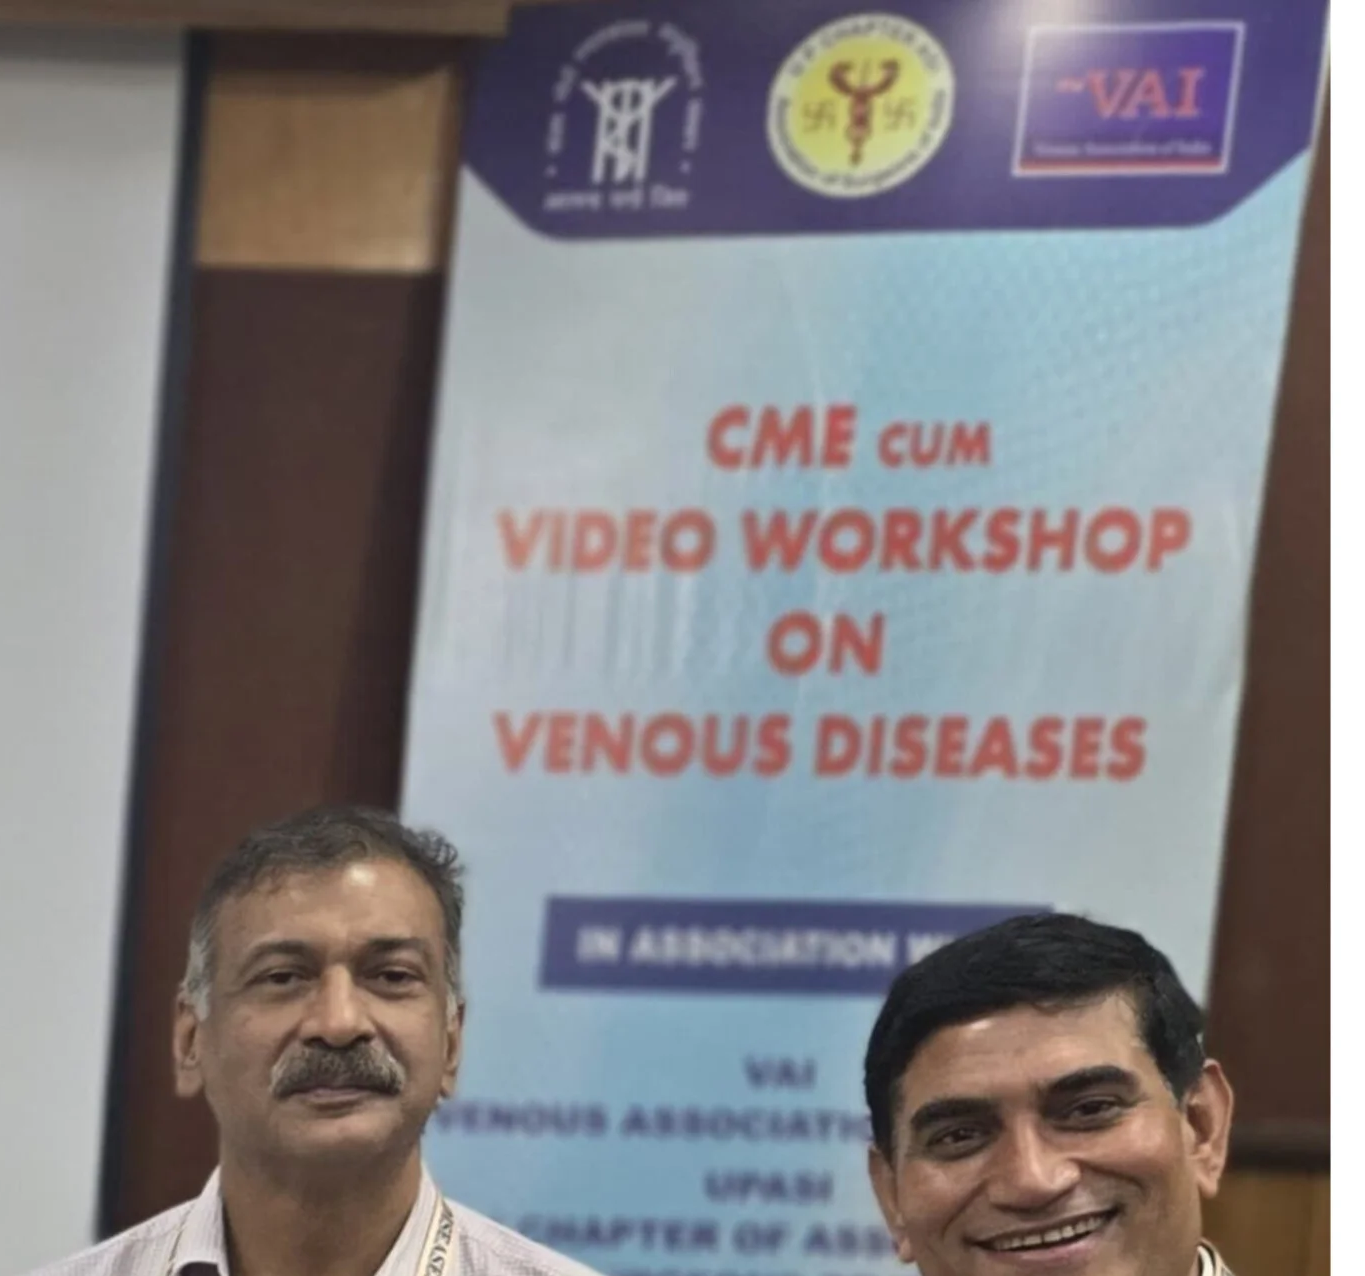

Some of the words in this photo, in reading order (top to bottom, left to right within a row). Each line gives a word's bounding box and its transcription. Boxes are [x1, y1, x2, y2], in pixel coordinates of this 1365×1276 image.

[1086, 67, 1205, 119] VAI
[706, 405, 857, 471] CME
[878, 422, 991, 469] CUM
[496, 508, 715, 574] VIDEO
[741, 507, 1192, 575] WORKSHOP
[766, 610, 886, 676] ON
[493, 710, 794, 778] VENOUS
[814, 714, 1148, 782] DISEASES
[576, 927, 618, 963] IN
[628, 927, 896, 967] ASSOCIATION
